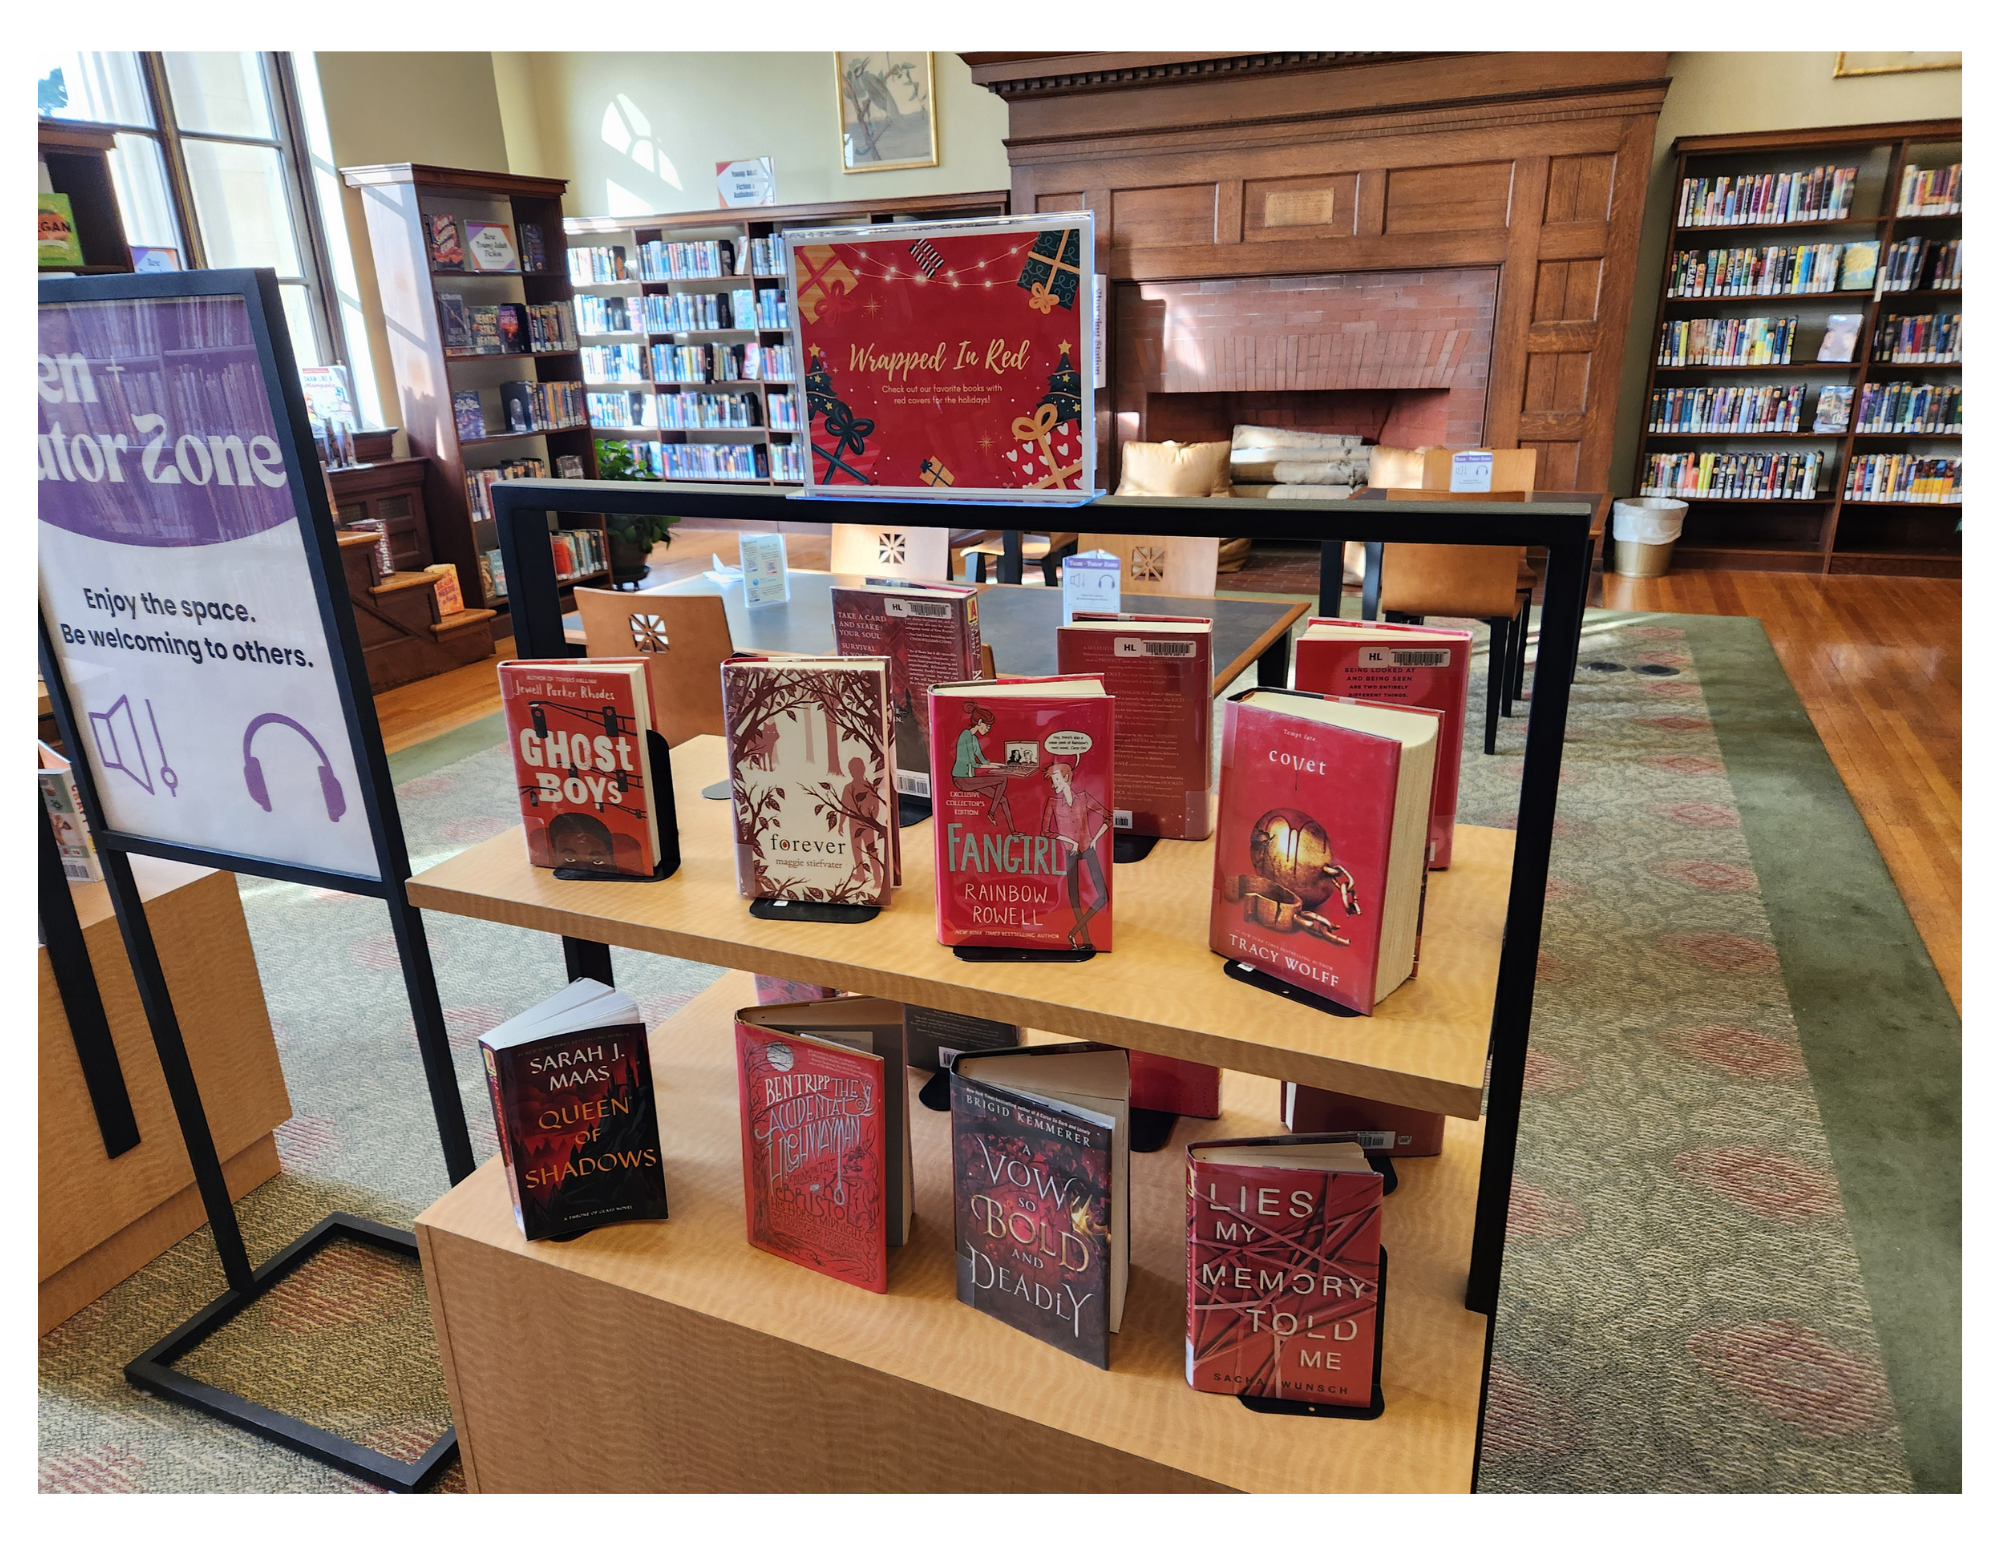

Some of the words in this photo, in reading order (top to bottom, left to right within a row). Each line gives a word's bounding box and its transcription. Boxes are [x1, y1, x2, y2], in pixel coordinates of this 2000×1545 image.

[850, 342, 947, 382] Wrapped
[953, 340, 979, 370] In
[985, 339, 1030, 375] Red
[881, 385, 905, 394] Check
[933, 385, 961, 393] favorite
[963, 384, 985, 392] books
[986, 383, 1003, 392] with
[894, 396, 906, 404] red
[908, 397, 931, 405] covers
[933, 395, 944, 404] for
[944, 395, 957, 404] the
[958, 395, 991, 405] holidays!
[131, 413, 287, 488] Zone
[83, 587, 136, 620] Enjoy
[141, 592, 177, 616] the
[182, 600, 257, 625] space.
[864, 614, 887, 622] CARD
[892, 603, 903, 611] HL
[60, 623, 86, 645] Be
[88, 626, 204, 665] welcoming
[204, 637, 228, 660] to
[232, 640, 315, 668] others.
[839, 629, 860, 638] YOUR
[841, 642, 876, 652] SURVIVAL
[1368, 653, 1382, 661] HL
[514, 680, 542, 696] Jewell
[546, 683, 577, 698] Parker
[581, 685, 615, 700] Rhodes
[945, 799, 985, 807] COLLECTOR'S
[770, 834, 846, 854] forever
[947, 823, 1068, 876] FANGIRL
[775, 859, 804, 868] maggie
[806, 858, 843, 870] stiefvater
[964, 883, 1048, 904] RAINBOW
[972, 906, 1043, 926] ROWELL
[1229, 933, 1279, 963] TRACY
[1285, 956, 1340, 988] WOLFF
[529, 1045, 603, 1075] SARAH
[611, 1042, 626, 1062] J.
[549, 1065, 611, 1092] MAAS
[765, 1074, 793, 1107] BEN
[793, 1074, 831, 1097] TRIPP
[831, 1077, 859, 1098] THE
[538, 1096, 630, 1130] QUEEN
[757, 1093, 858, 1136] ACCIDENTAL
[966, 1094, 1011, 1118] BRIGID
[1017, 1112, 1092, 1148] KEMMERER
[574, 1127, 602, 1145] OF
[1022, 1144, 1032, 1156] A
[525, 1148, 658, 1189] SHADOWS
[976, 1134, 1078, 1211] VOW
[1018, 1196, 1037, 1212] SO
[1210, 1182, 1313, 1218] LIES
[970, 1194, 1091, 1273] BOLD
[1216, 1220, 1257, 1243] MY
[1011, 1248, 1044, 1270] AND
[965, 1238, 1095, 1338] DEADLY
[1202, 1263, 1366, 1300] MEMORY
[1245, 1308, 1358, 1342] TOLD
[1300, 1349, 1342, 1371] ME
[1213, 1372, 1265, 1387] SACHA
[1281, 1380, 1349, 1396] WUNSCH
